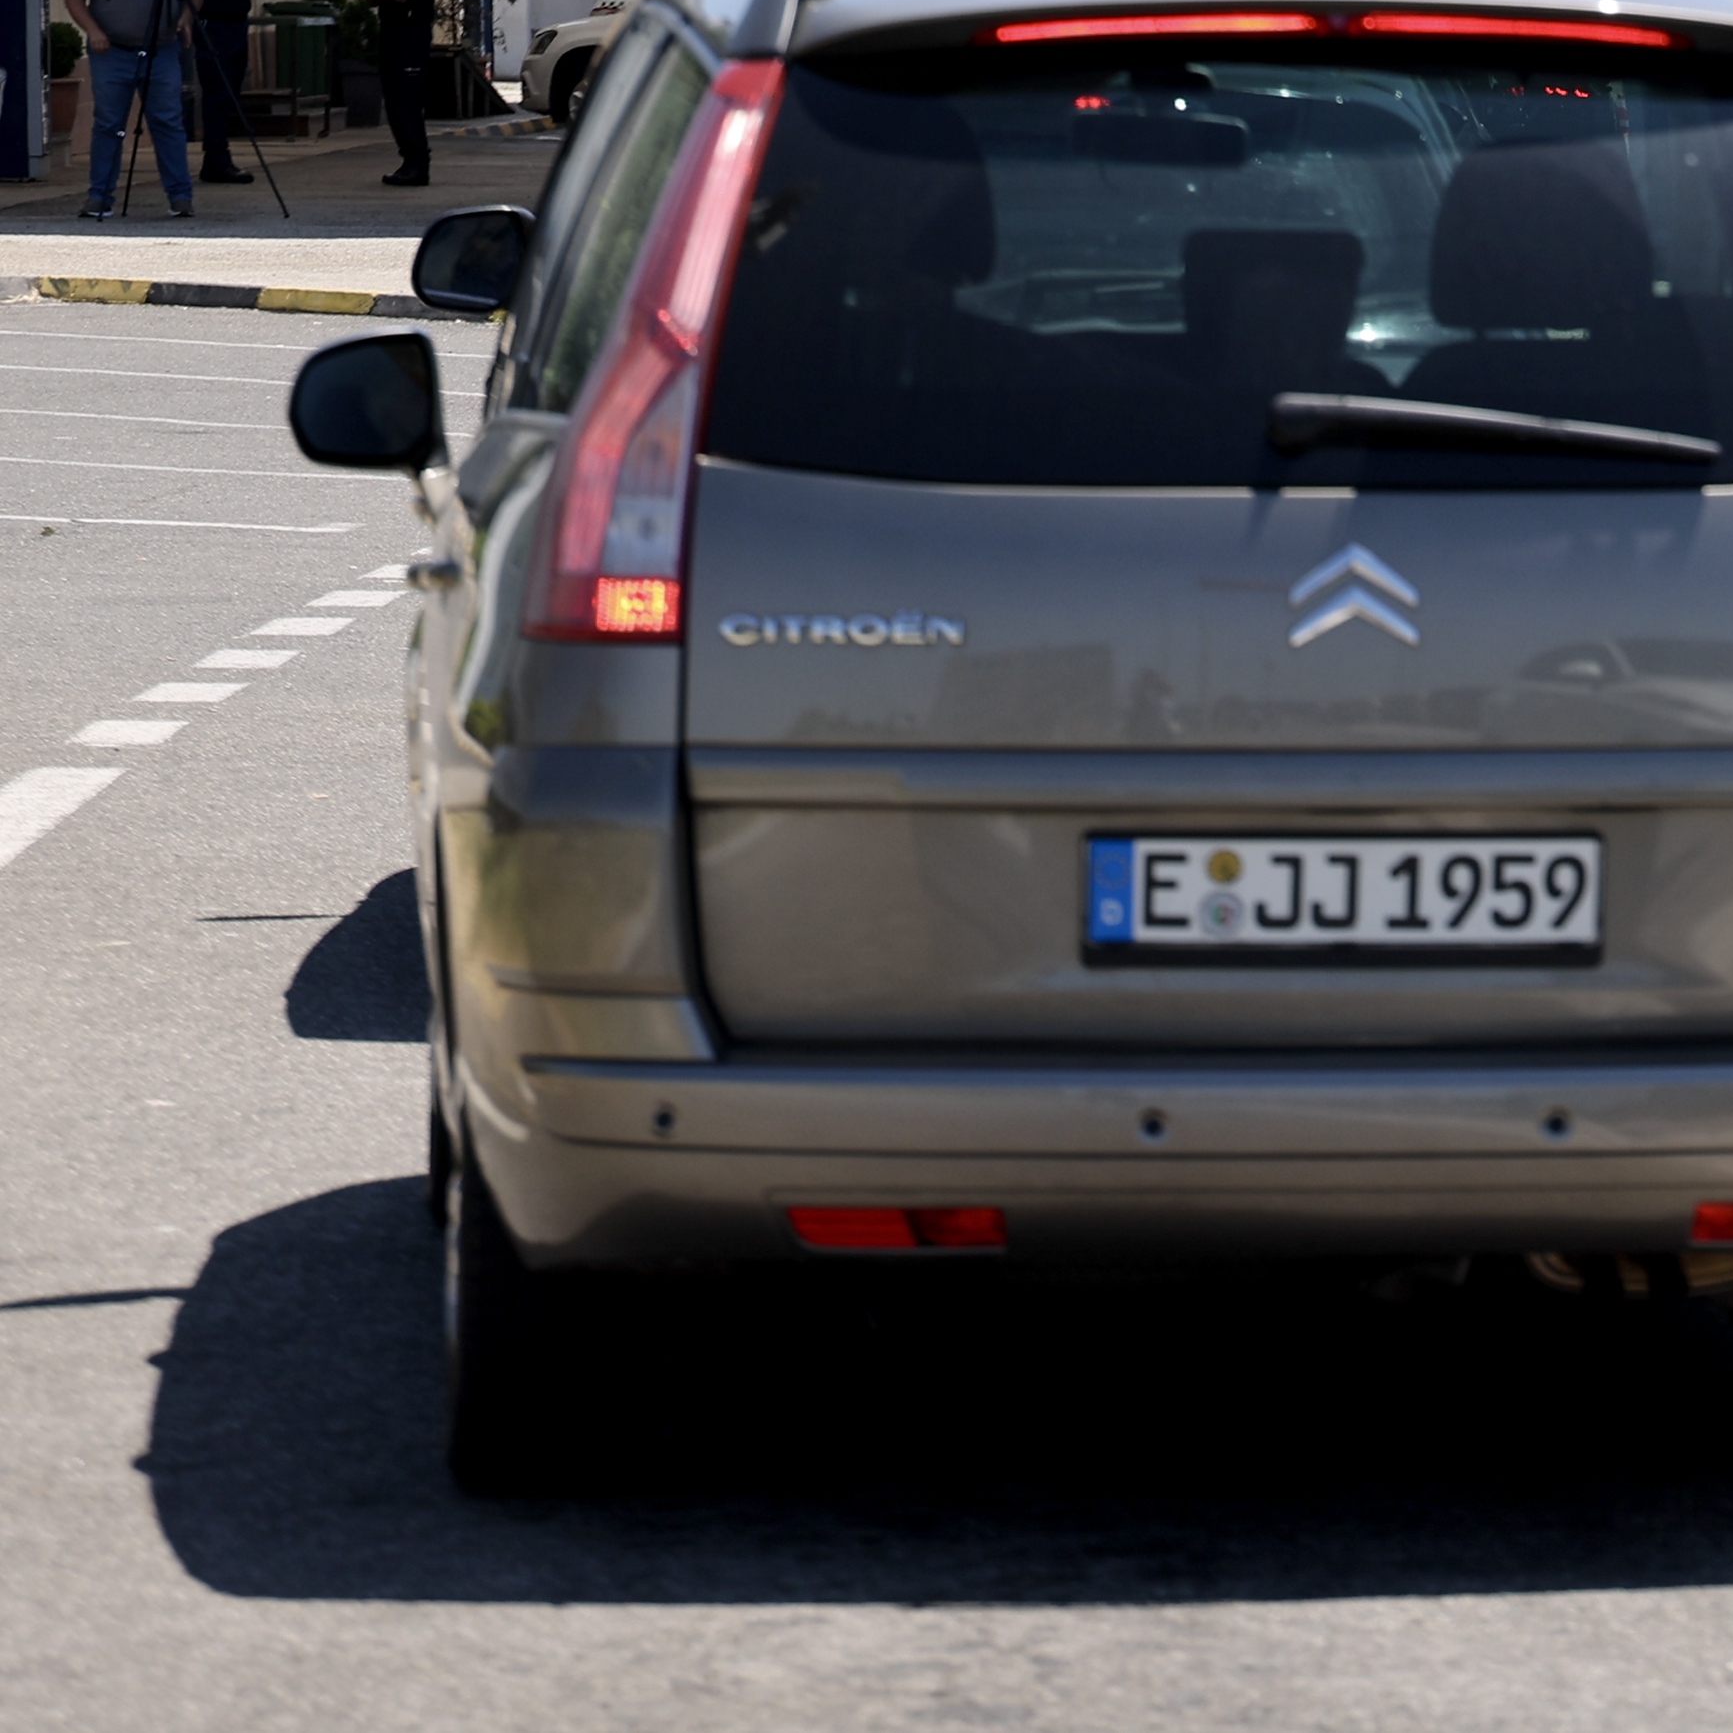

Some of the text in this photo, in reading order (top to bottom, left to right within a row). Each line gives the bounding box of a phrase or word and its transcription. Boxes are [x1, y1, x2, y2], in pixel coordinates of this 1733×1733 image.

[1142, 853, 1588, 930] E JJ 1959
